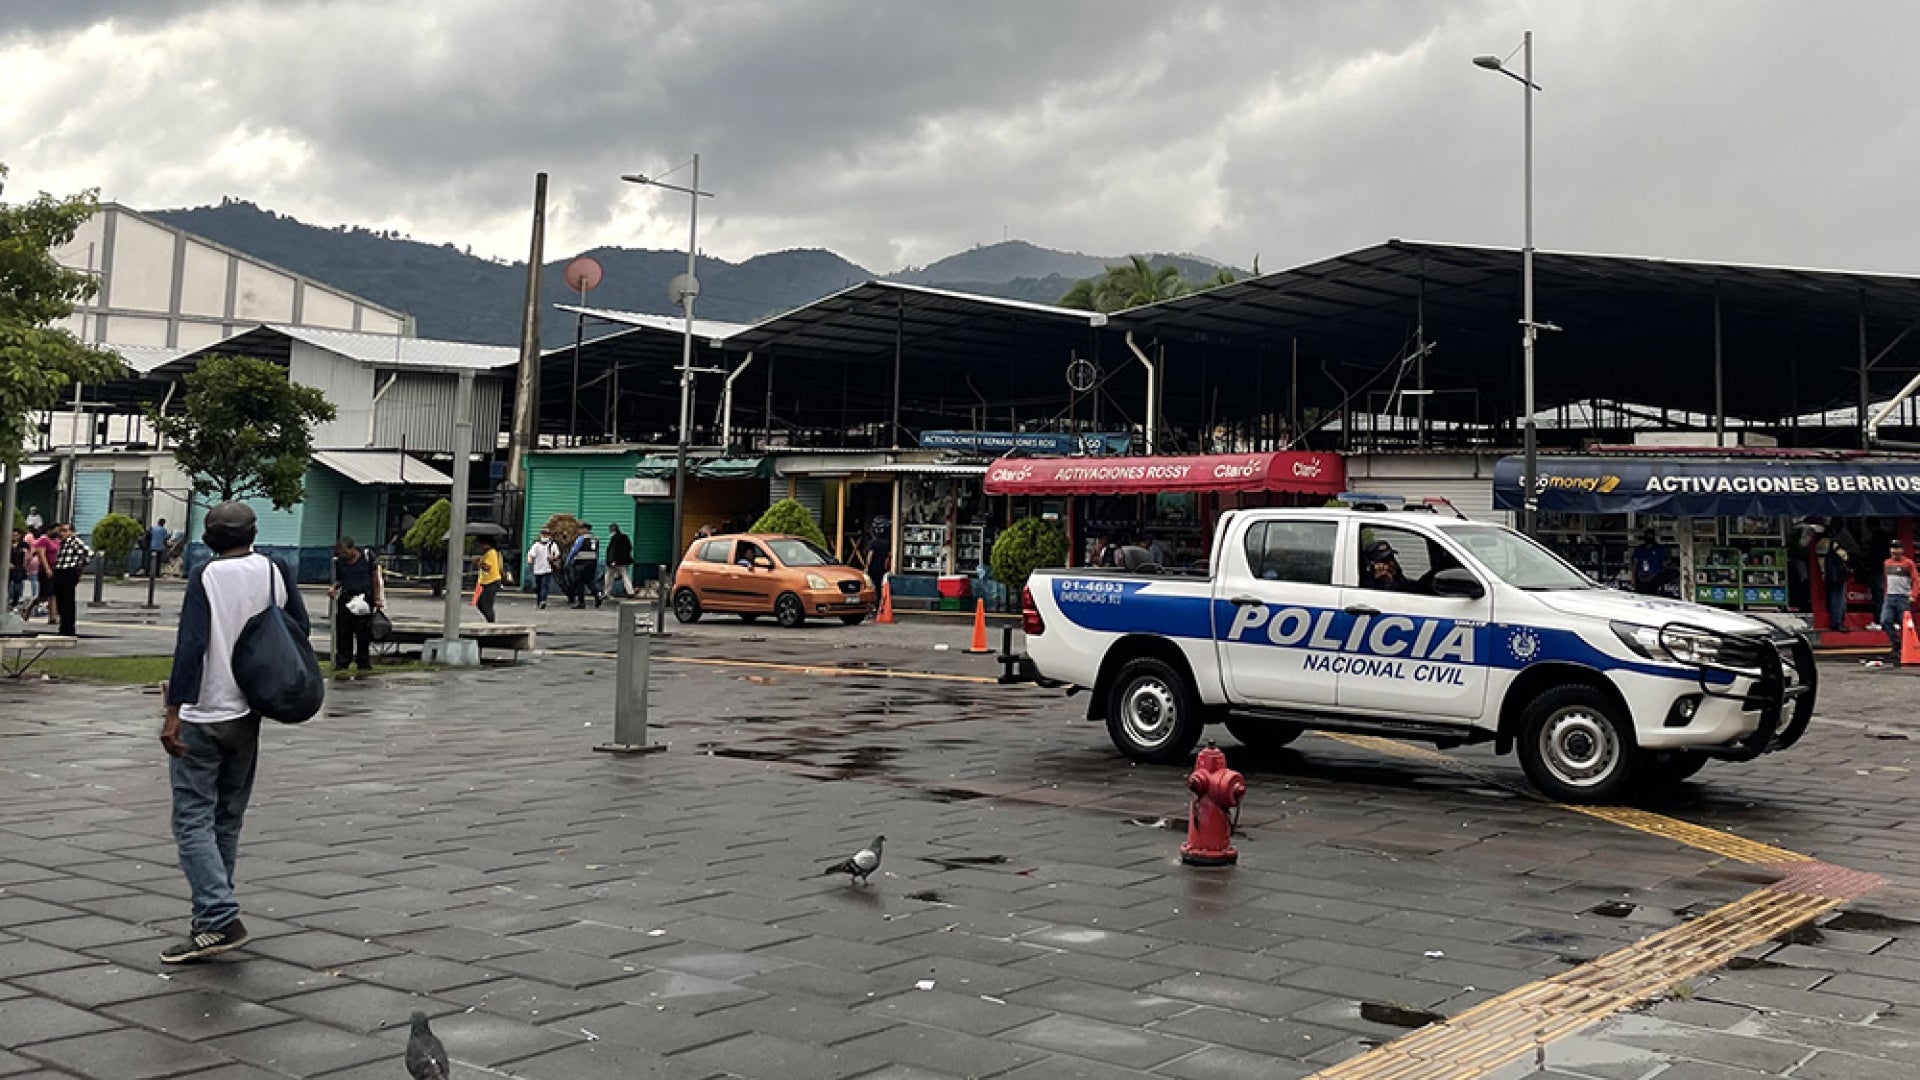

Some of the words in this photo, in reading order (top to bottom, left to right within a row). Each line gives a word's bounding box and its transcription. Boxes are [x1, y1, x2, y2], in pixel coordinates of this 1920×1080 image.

[992, 466, 1027, 481] Claro
[1054, 466, 1143, 481] ACTIVACIONES
[1144, 465, 1191, 479] ROSSY
[1213, 464, 1253, 478] Claro
[1646, 475, 1819, 493] ACTIVACIONES
[1227, 604, 1476, 663] POLICIA
[1303, 654, 1406, 680] NACIONAL
[1414, 664, 1465, 686] CIVIL
